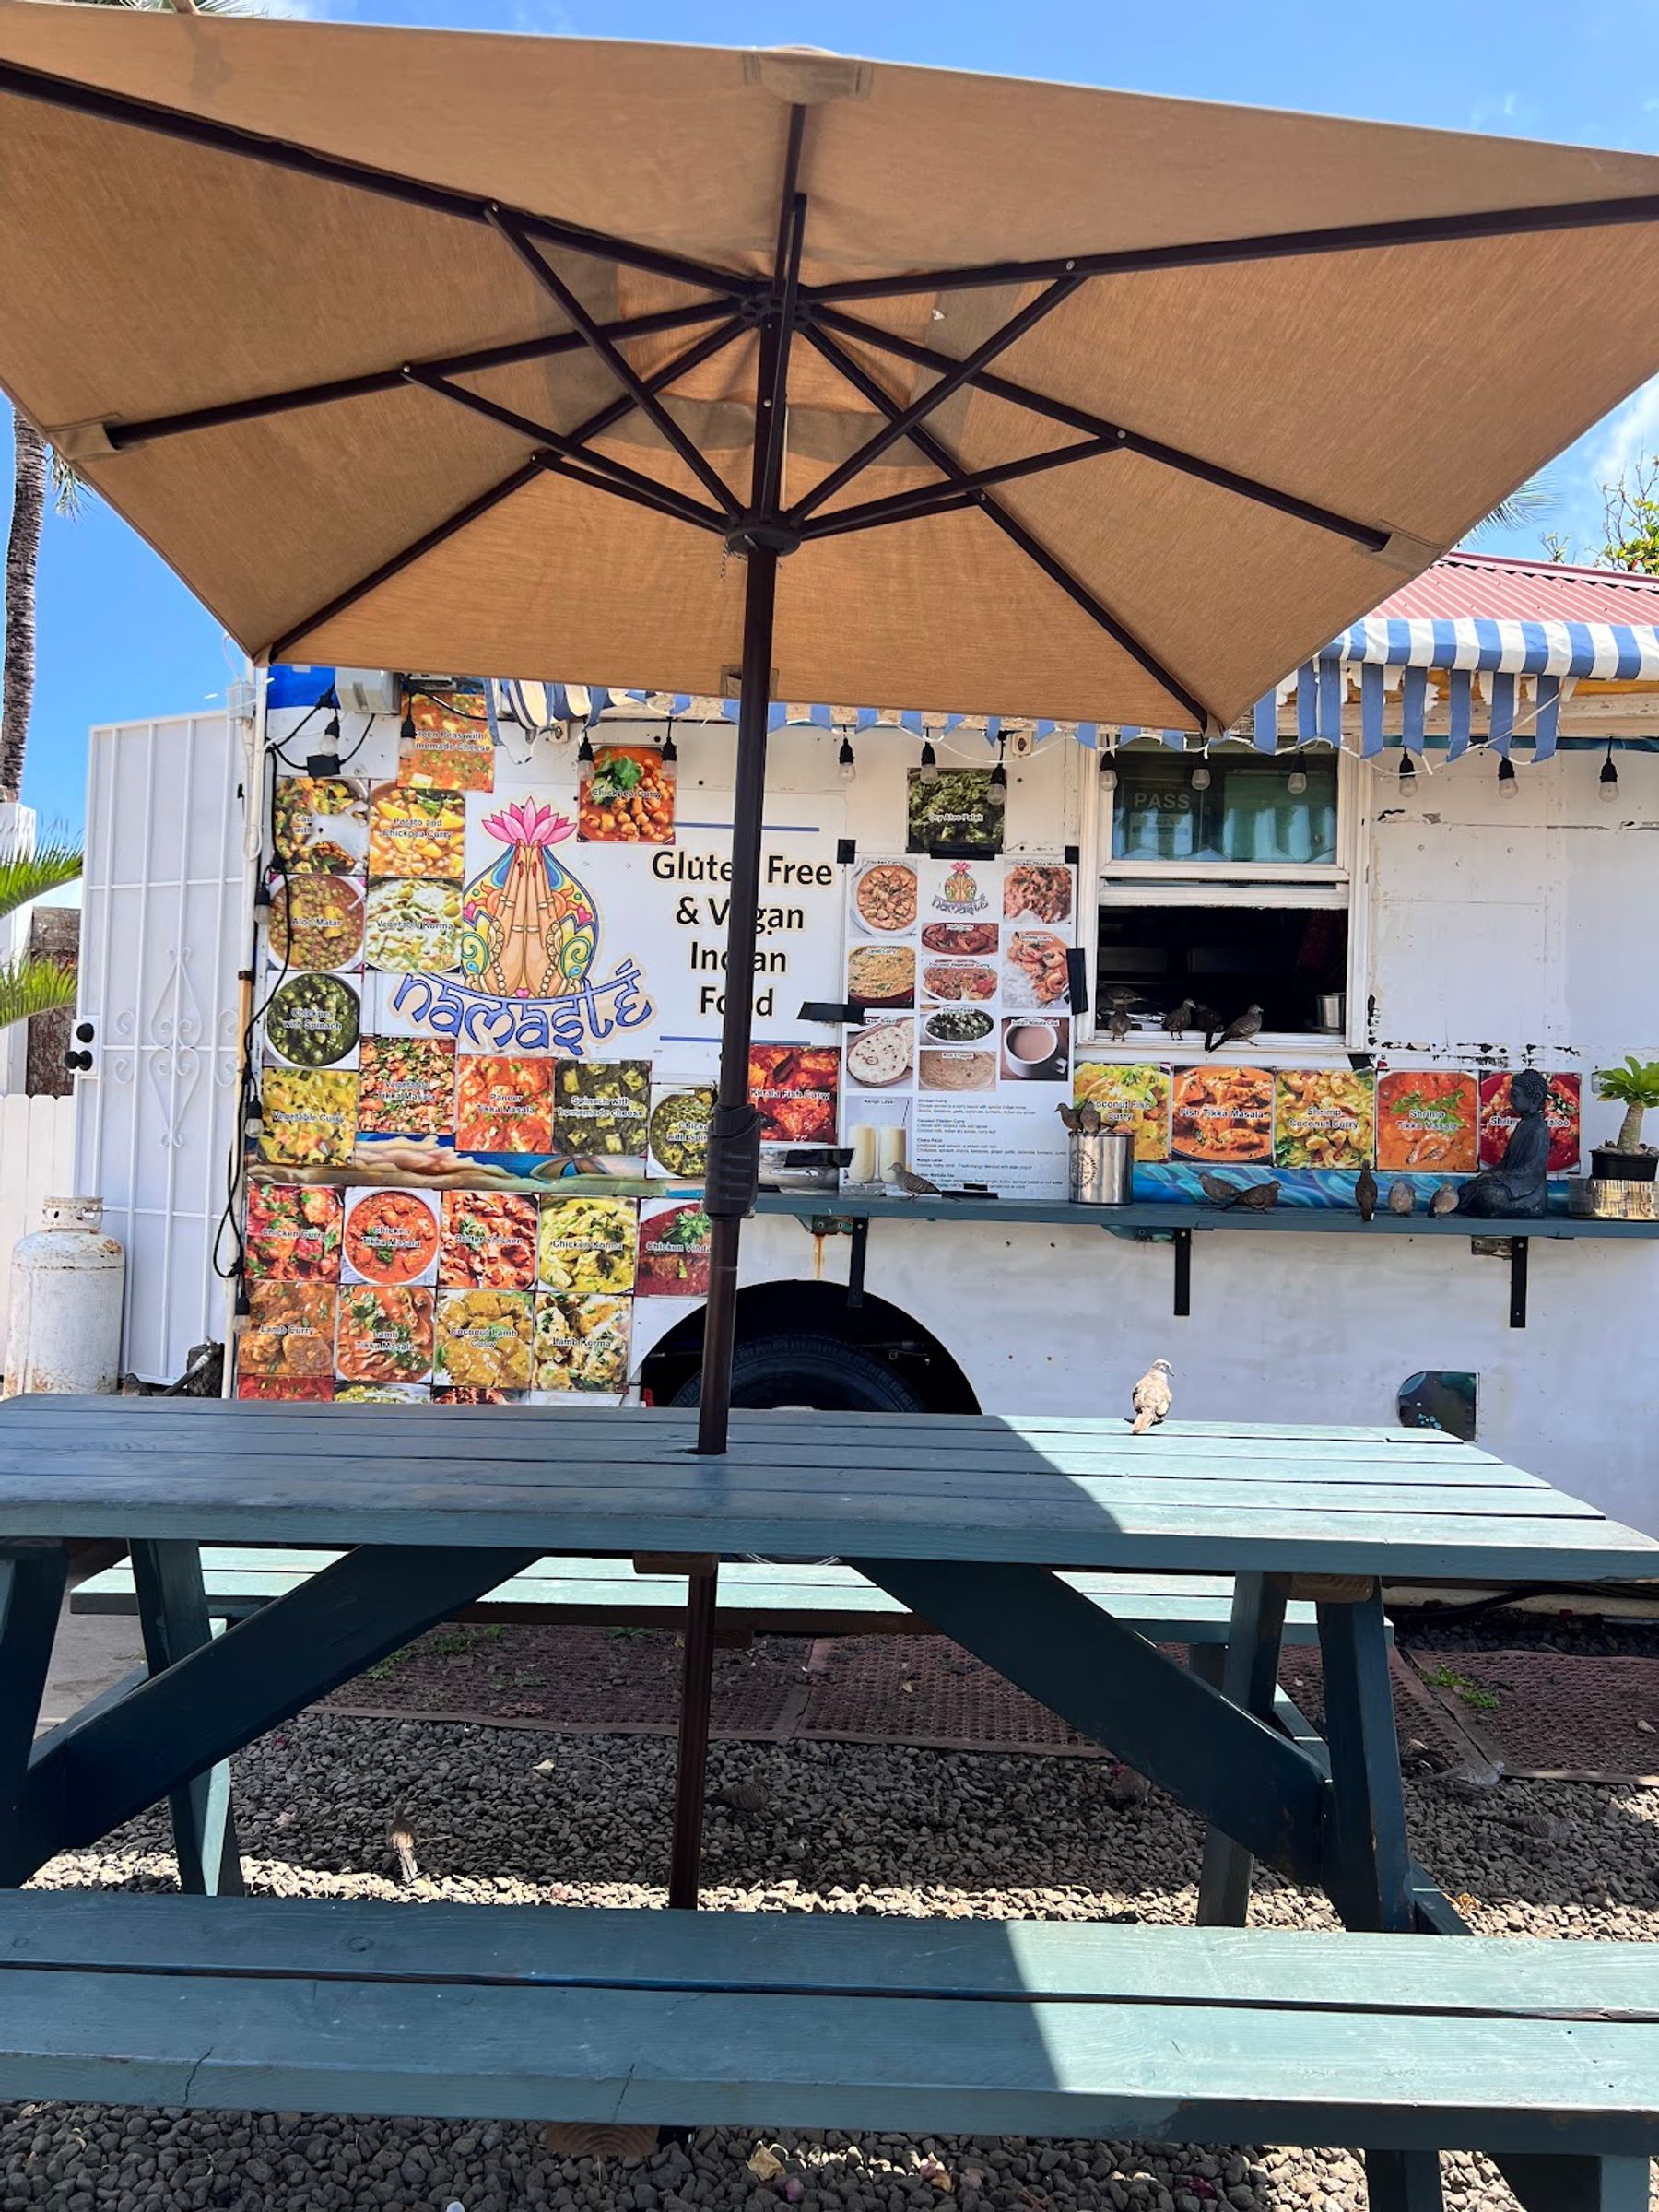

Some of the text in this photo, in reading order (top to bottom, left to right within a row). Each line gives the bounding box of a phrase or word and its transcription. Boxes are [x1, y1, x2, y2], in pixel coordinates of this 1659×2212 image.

[592, 788, 661, 800] Chickpea Curry
[1134, 793, 1191, 810] PASS
[394, 818, 442, 828] Potato and
[382, 830, 452, 841] Chickpea Curry
[652, 851, 833, 886] Glute Free
[675, 895, 805, 935] & Vgan
[316, 917, 341, 927] Matar
[376, 921, 453, 932] Vegetable Korma
[690, 940, 787, 973] Inan
[700, 985, 774, 1017] Fd
[283, 1018, 342, 1031] with Spinach
[377, 1090, 436, 1101] Tikka Masala
[489, 1092, 524, 1102] Paneer
[750, 1088, 780, 1099] Kerala
[782, 1088, 803, 1099] Fish
[571, 1096, 630, 1107] Spinach with
[503, 1104, 535, 1114] Masala
[557, 1107, 644, 1118] homemade cheese
[1180, 1107, 1265, 1119] Fish Tikka Masala
[1307, 1106, 1342, 1117] Shrimp
[1409, 1109, 1445, 1120] Shrimp
[319, 1112, 346, 1124] Curry
[1491, 1115, 1519, 1126] Shrim
[677, 1121, 709, 1131] Chicke
[1288, 1119, 1359, 1130] Coconut Curry
[262, 1229, 327, 1241] Chicken Curry
[372, 1226, 410, 1236] Chicken
[361, 1235, 420, 1248] Tikka Masala
[486, 1235, 523, 1244] Chicken
[552, 1239, 623, 1251] Chicken Korma
[647, 1241, 684, 1252] Chicken
[260, 1325, 314, 1336] Lamb Curry
[373, 1330, 399, 1339] Lamb
[450, 1327, 518, 1337] Coconut Lamb
[356, 1340, 415, 1352] Tikka Masala
[552, 1337, 612, 1348] Lamb Korma
